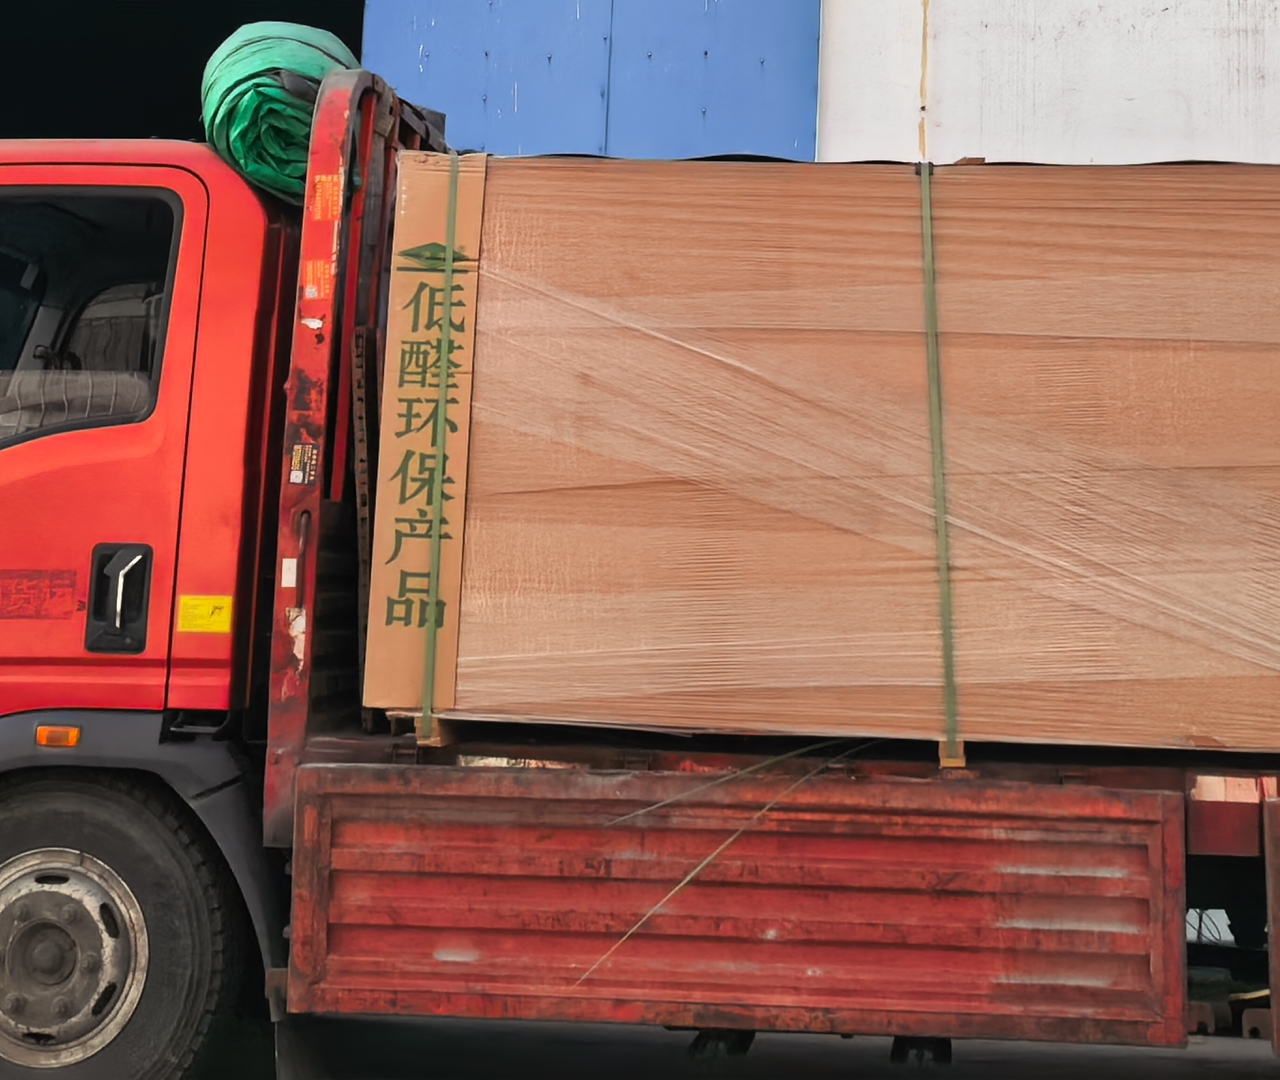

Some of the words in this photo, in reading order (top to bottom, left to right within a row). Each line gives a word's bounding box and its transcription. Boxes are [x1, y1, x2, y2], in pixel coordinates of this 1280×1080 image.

[385, 281, 467, 628] 低醛环保产品
